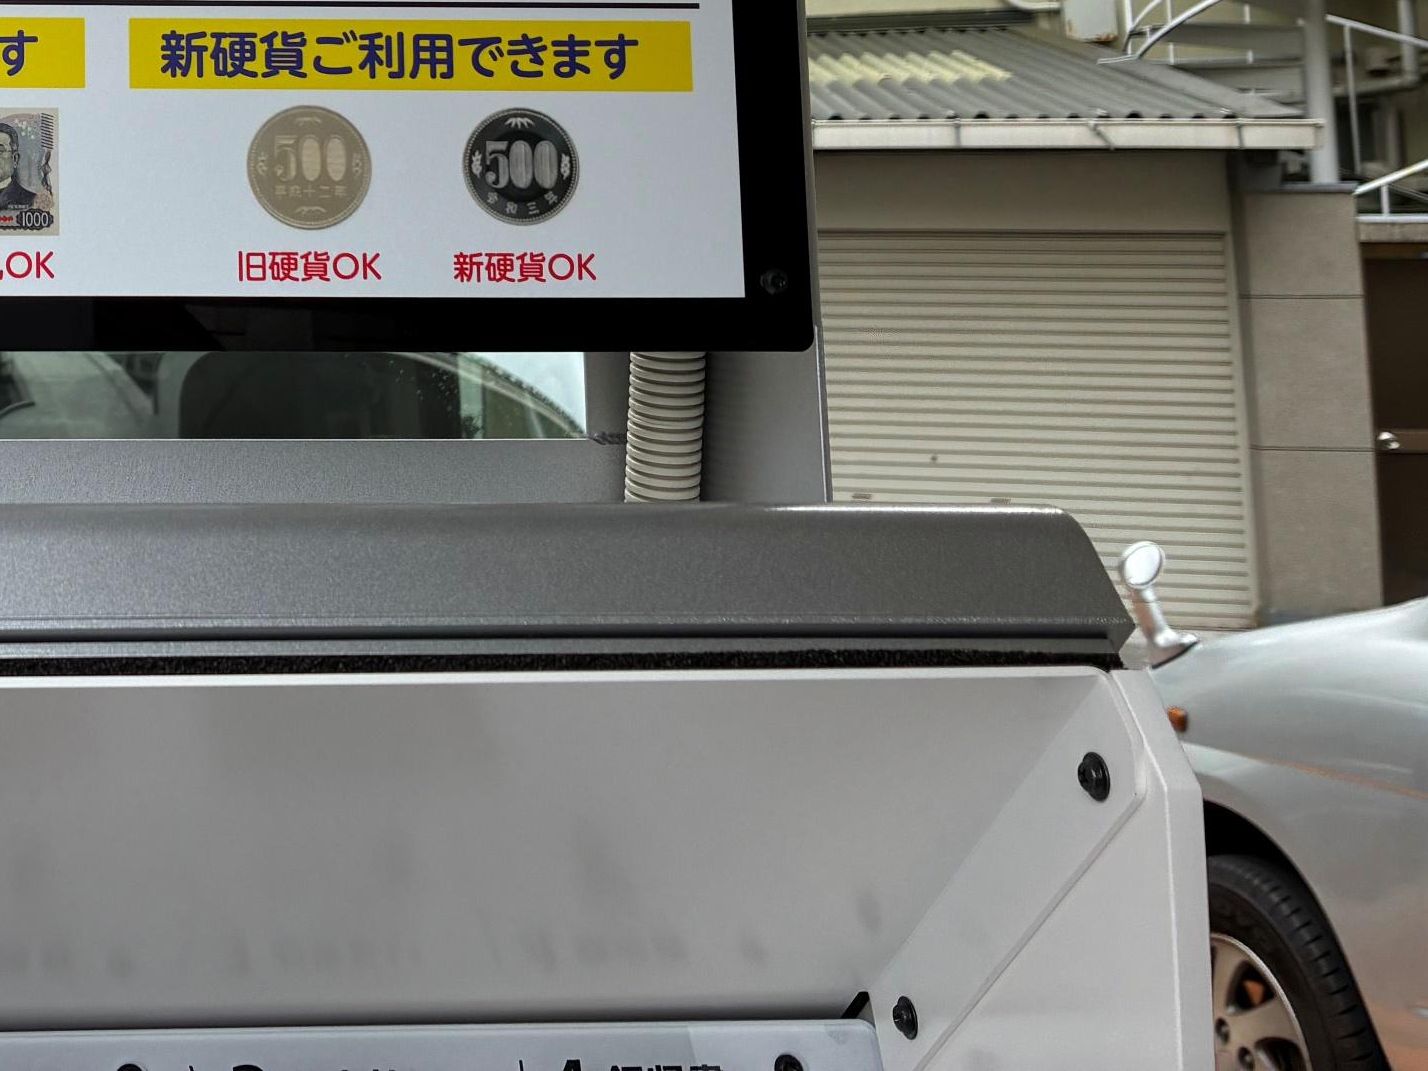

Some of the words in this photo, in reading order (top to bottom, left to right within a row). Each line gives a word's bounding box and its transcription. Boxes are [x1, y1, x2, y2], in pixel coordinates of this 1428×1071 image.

[161, 30, 639, 80] 新硬貨ご利用できます
[274, 134, 346, 182] 500
[485, 140, 558, 189] 500
[22, 212, 50, 227] 1000
[238, 251, 382, 282] 旧硬貨OK
[454, 252, 597, 282] 新硬貨OK
